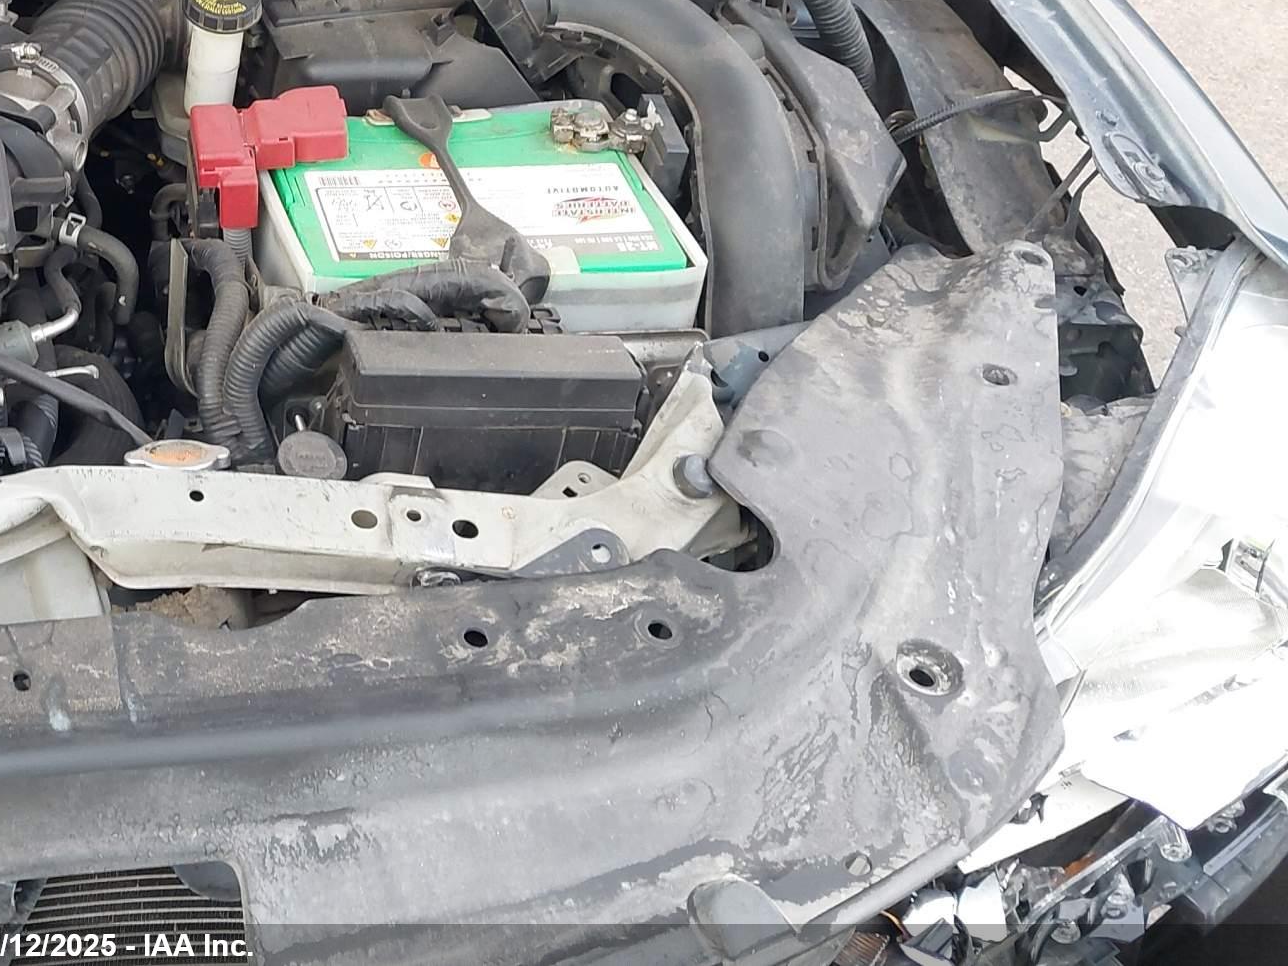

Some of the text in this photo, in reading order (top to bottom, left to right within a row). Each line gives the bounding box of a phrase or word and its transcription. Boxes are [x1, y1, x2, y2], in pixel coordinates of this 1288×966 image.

[547, 186, 619, 195] AUTOMOTIVE
[555, 200, 631, 210] BATTERIES
[552, 207, 635, 217] INTERSTATE
